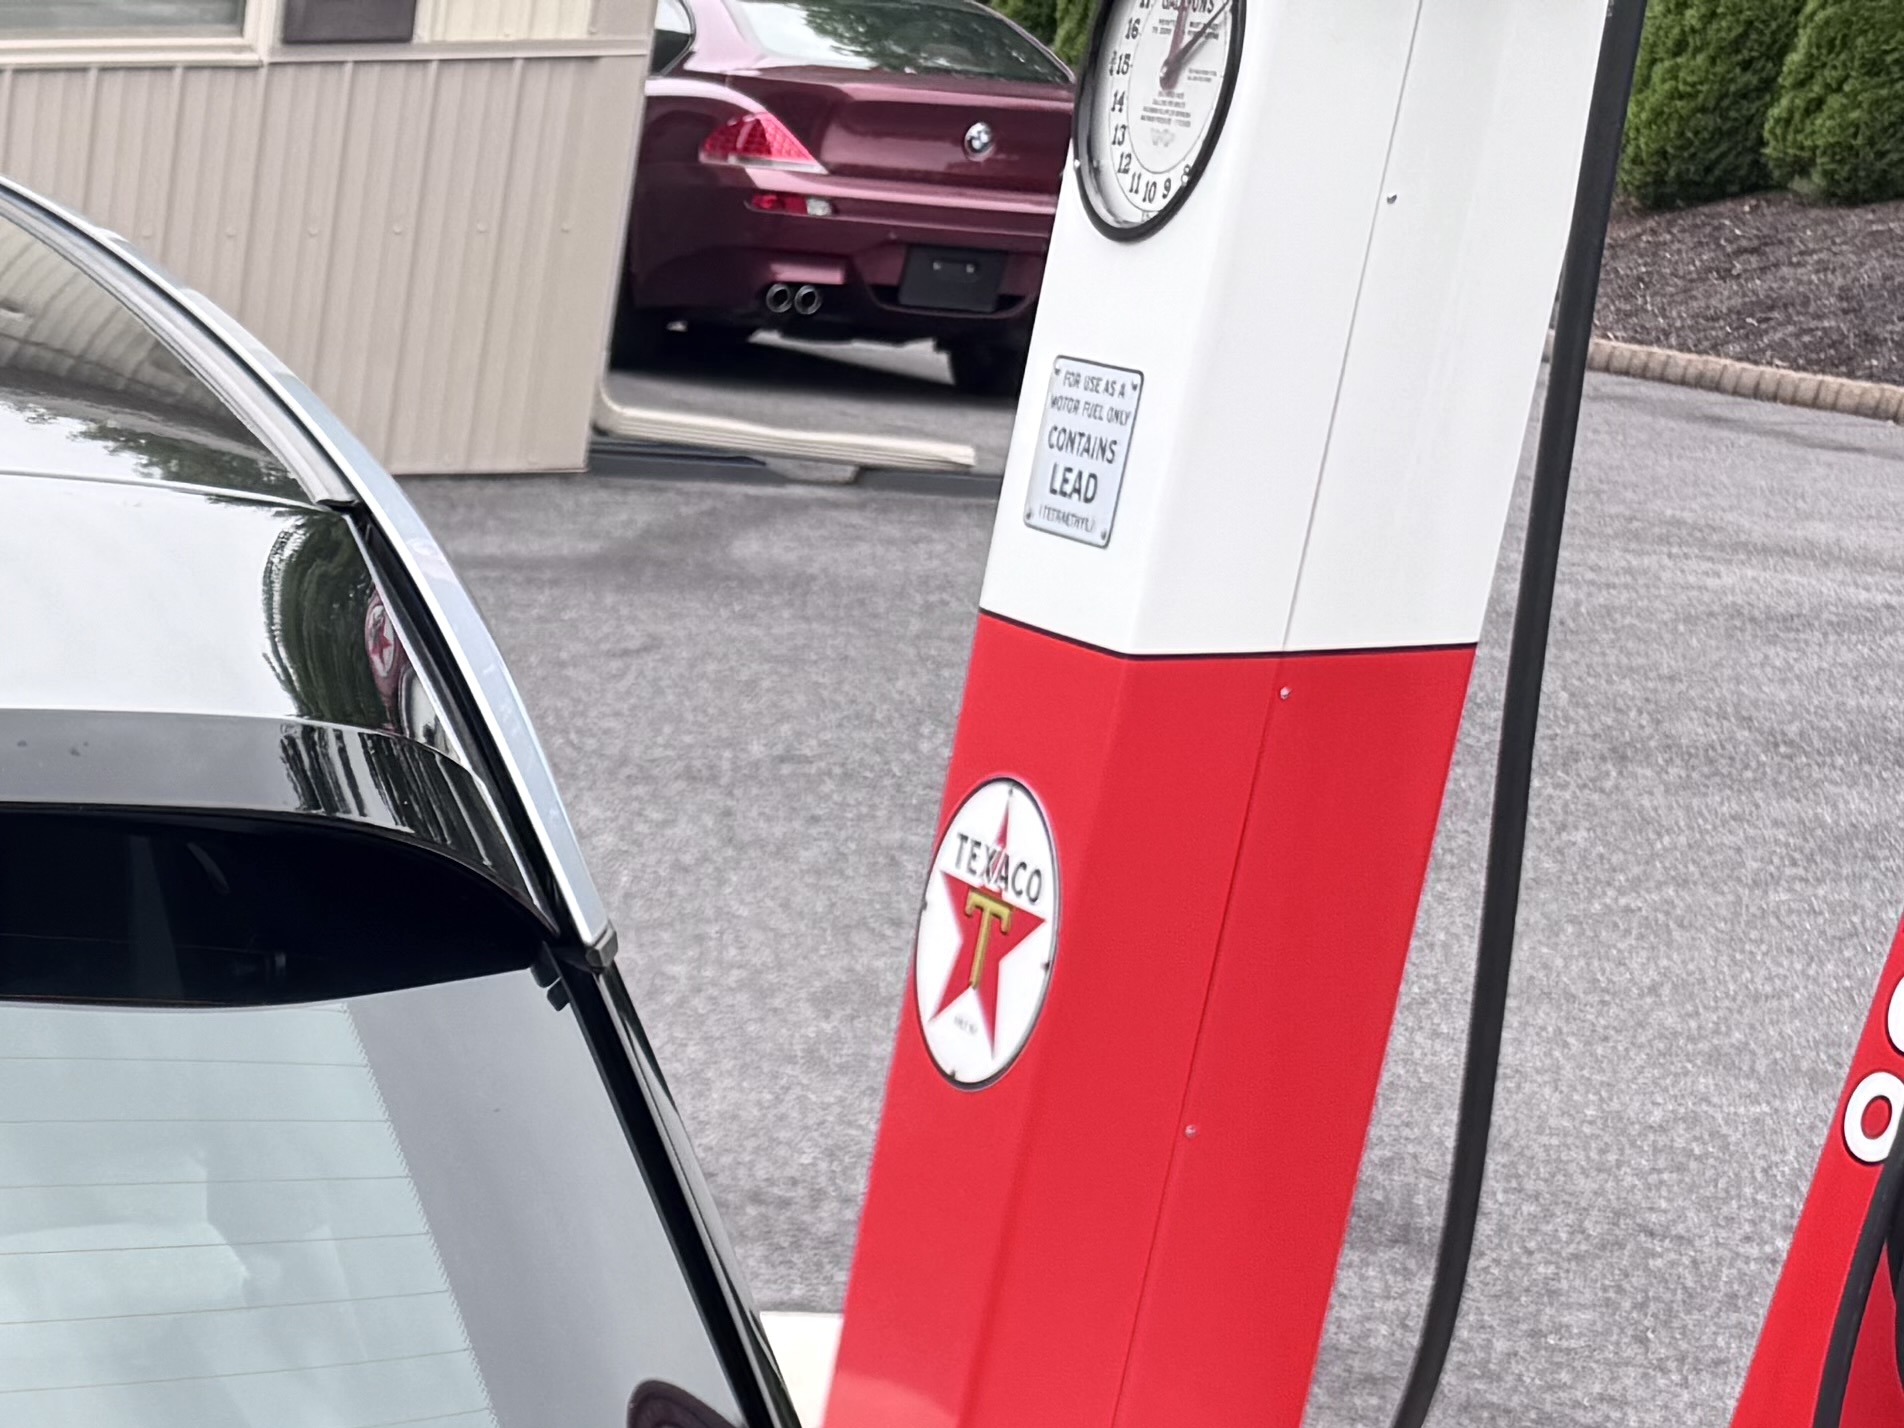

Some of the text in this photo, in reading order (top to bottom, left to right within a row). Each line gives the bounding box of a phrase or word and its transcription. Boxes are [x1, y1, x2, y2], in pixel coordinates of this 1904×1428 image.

[1125, 17, 1140, 40] 16
[1116, 53, 1131, 75] 15
[1111, 90, 1126, 113] 14
[1111, 124, 1127, 146] 13
[1117, 152, 1132, 174] 12
[1129, 173, 1141, 194] 11
[1142, 181, 1157, 204] 10
[1162, 178, 1171, 199] 9
[1063, 370, 1127, 399] FOR USE AS A
[1050, 395, 1131, 426] MOTOR FUEL ONLY
[1048, 425, 1118, 464] CONTAINS
[1049, 463, 1098, 504] LEAD
[955, 832, 1042, 904] TEXACO
